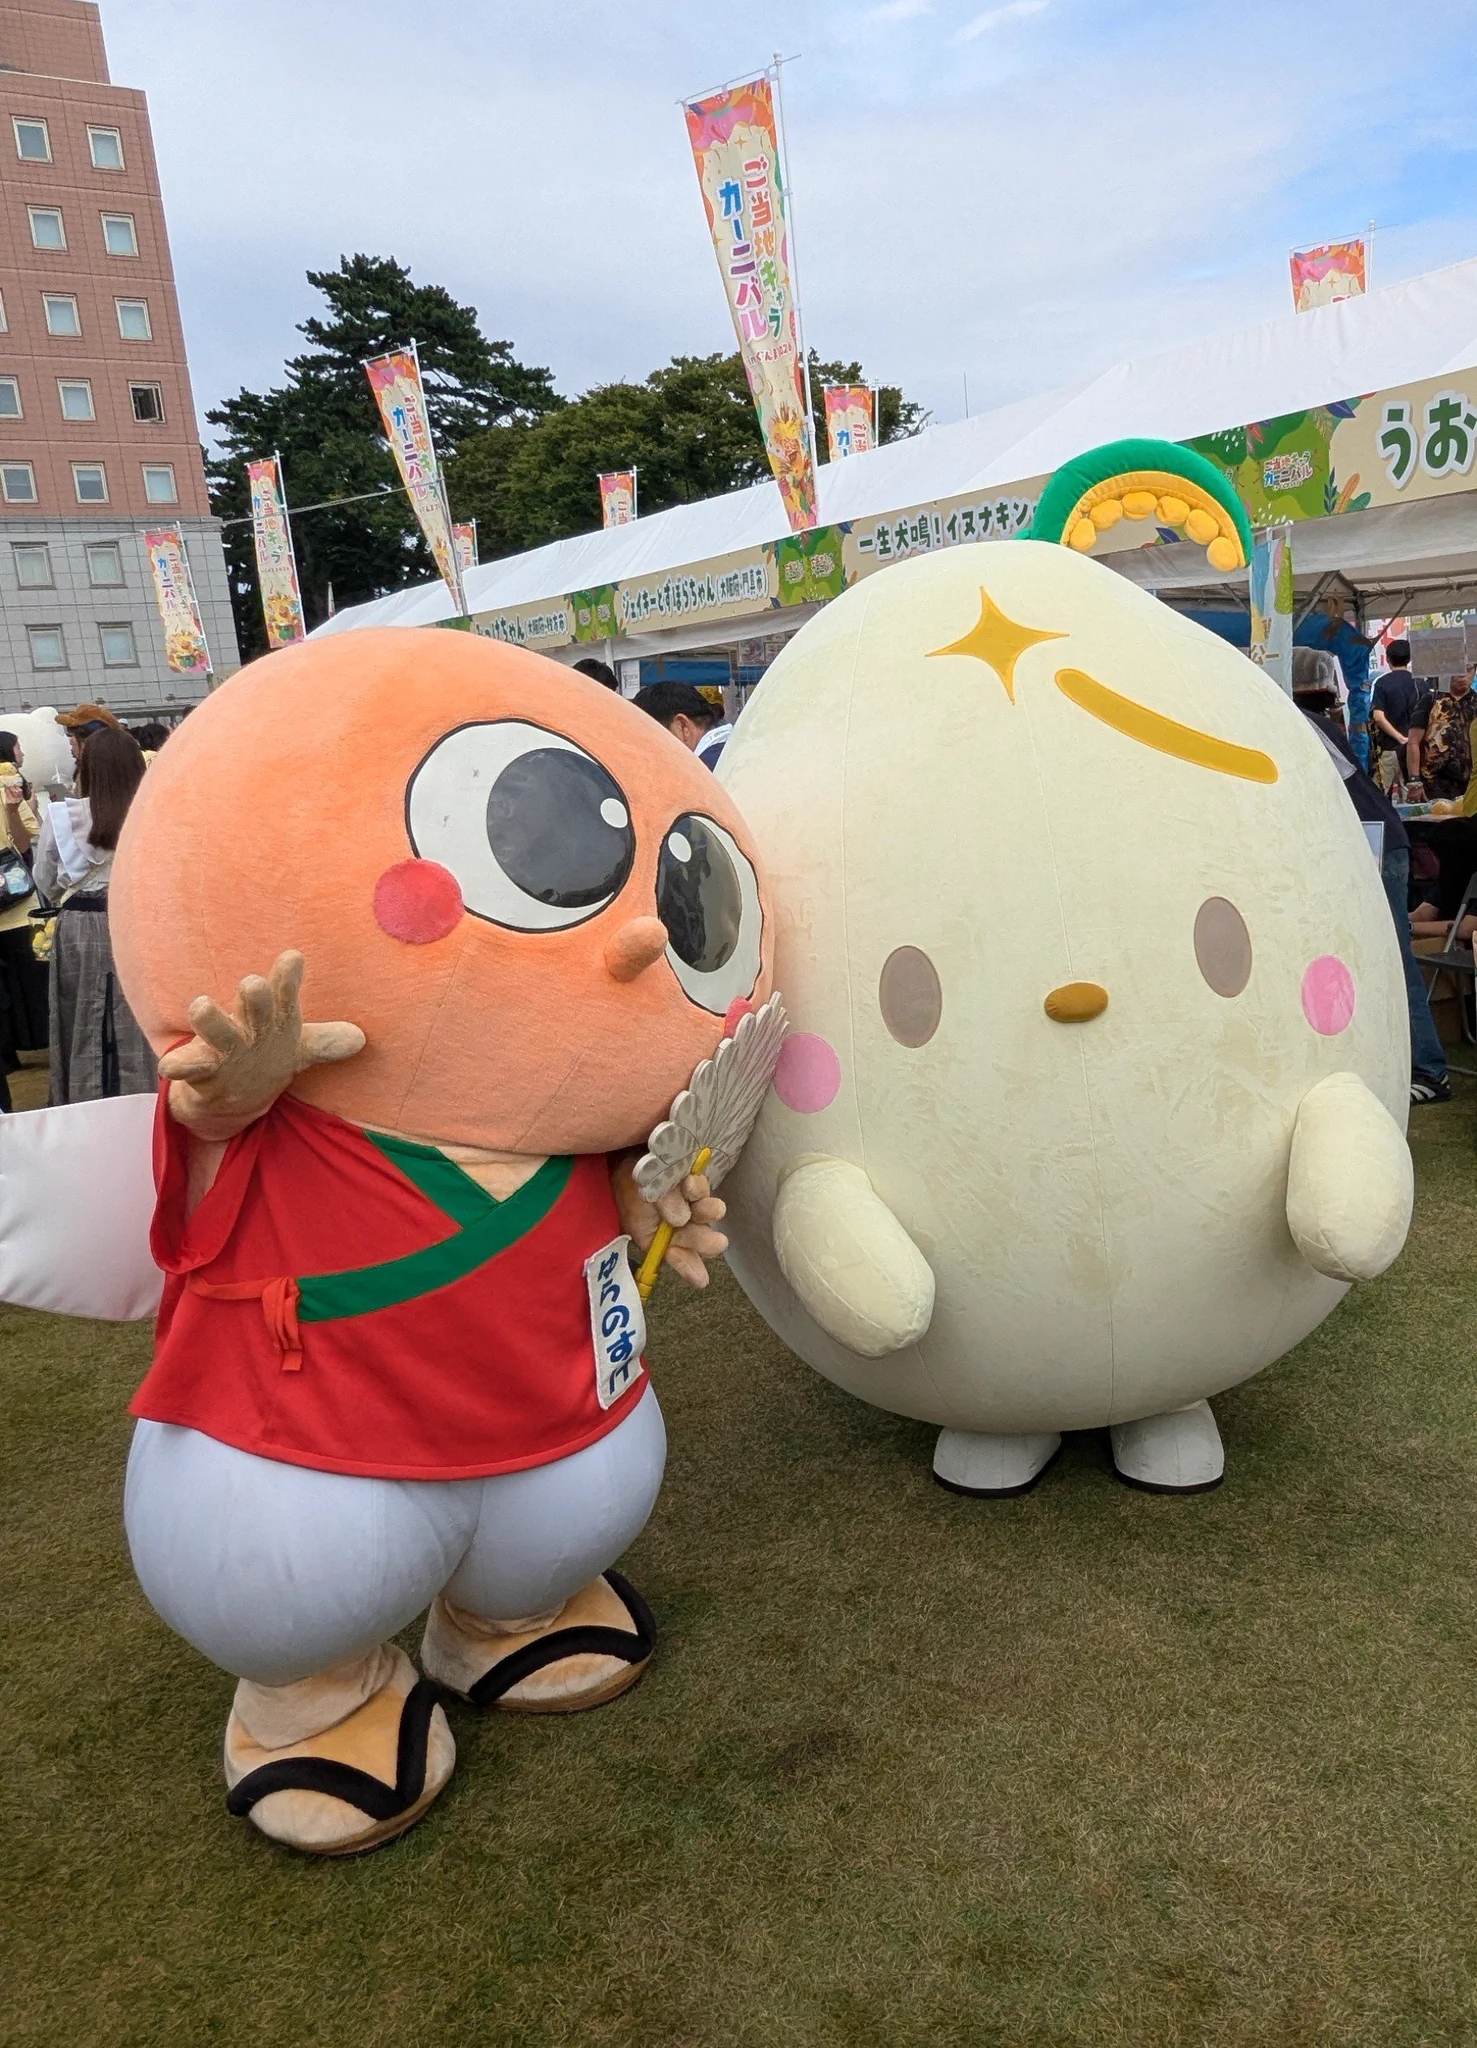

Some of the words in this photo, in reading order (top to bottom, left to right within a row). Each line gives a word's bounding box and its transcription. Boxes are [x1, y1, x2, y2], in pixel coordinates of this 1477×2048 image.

[719, 181, 767, 342] カーニバル
[744, 156, 783, 338] ご当地キャラ
[393, 407, 425, 498] カーニバル
[859, 500, 1037, 553] 一生犬鳴!イヌナキン
